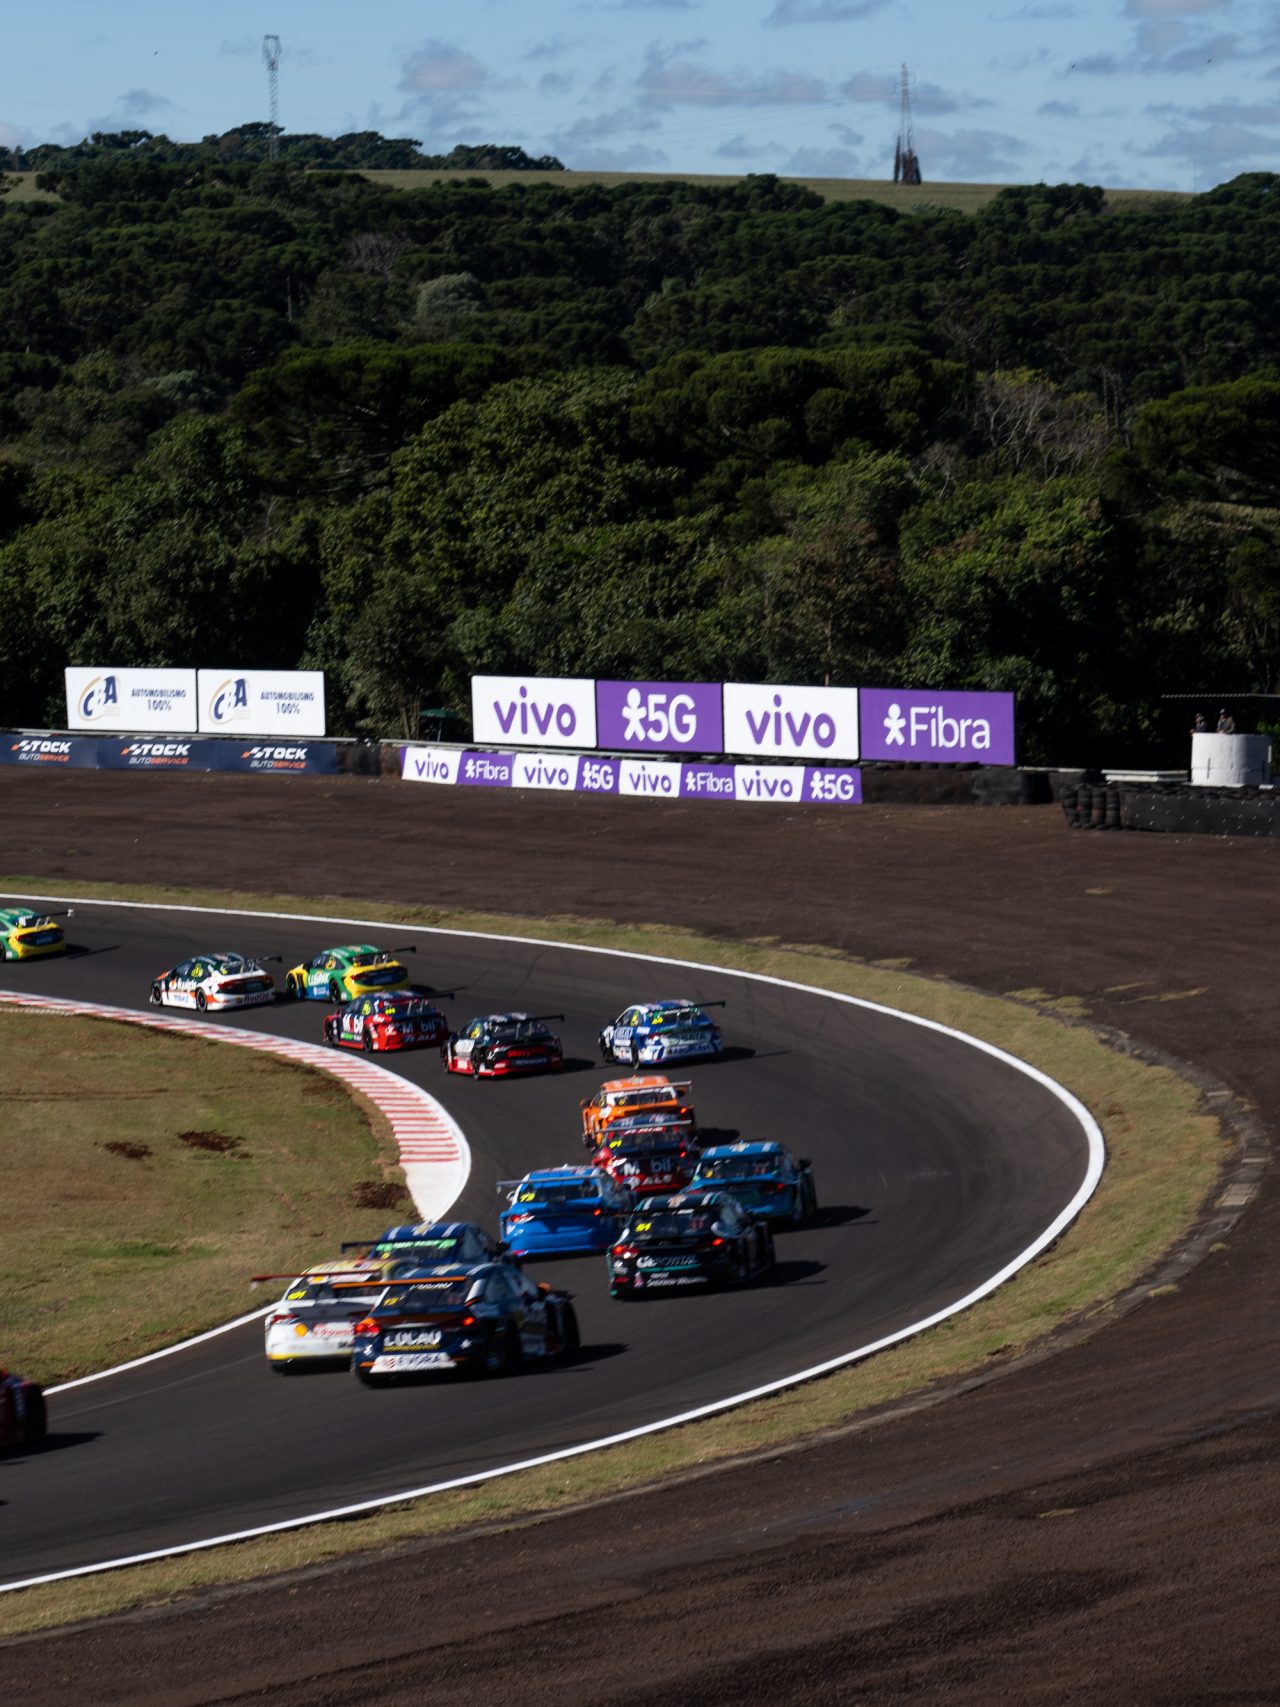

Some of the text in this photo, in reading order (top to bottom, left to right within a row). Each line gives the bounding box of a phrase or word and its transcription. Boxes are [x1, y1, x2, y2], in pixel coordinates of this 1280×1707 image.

[147, 700, 172, 711] 100%
[276, 703, 301, 714] 100%
[493, 686, 577, 737] vivo
[647, 693, 697, 743] 5G
[745, 694, 837, 748] vivo
[909, 706, 991, 750] Fibra
[17, 740, 72, 754] STOCK
[128, 743, 191, 756] STOCK
[249, 747, 308, 760] STOCK
[414, 753, 854, 800] vivo Fibra vivo 5G vivo Fibra vivo 5G
[623, 1157, 671, 1176] Mbil
